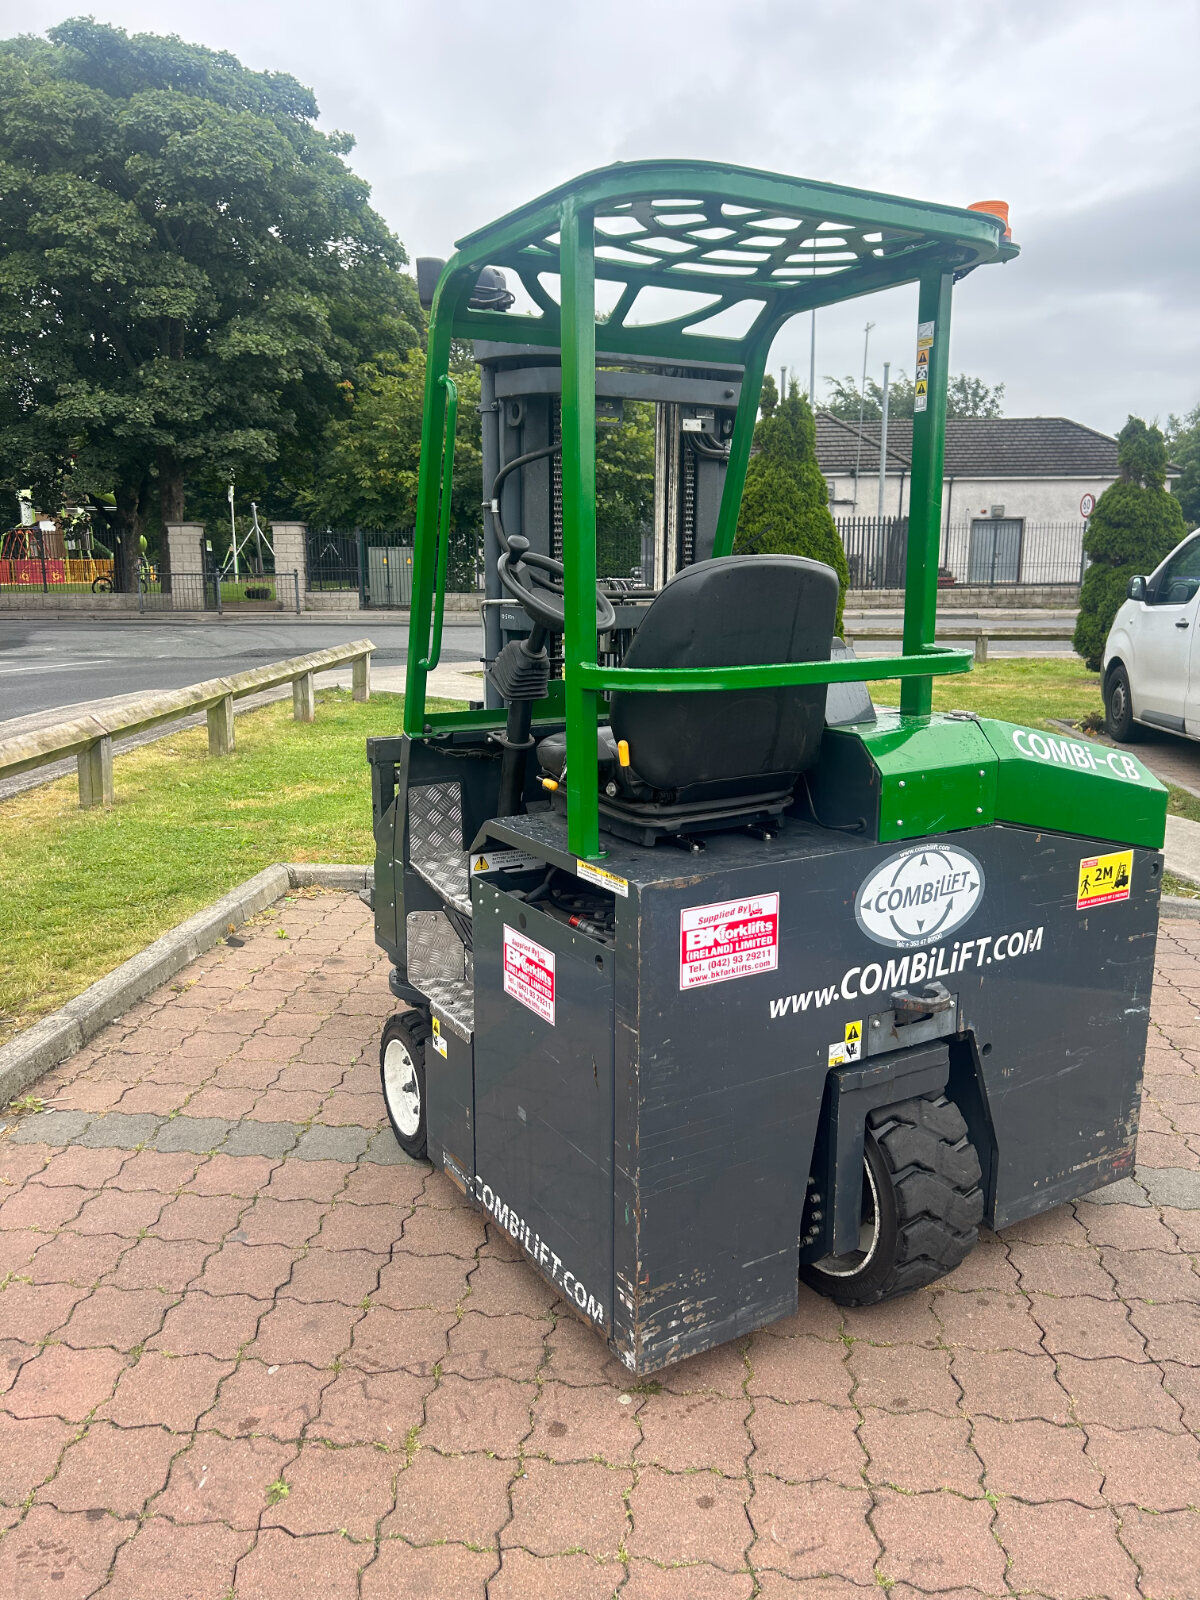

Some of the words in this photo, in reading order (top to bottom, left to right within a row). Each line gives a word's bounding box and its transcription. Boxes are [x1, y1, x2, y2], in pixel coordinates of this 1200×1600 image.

[899, 844, 951, 858] www.combilift.com
[1095, 866, 1113, 881] 2M
[698, 908, 735, 925] Supplied
[738, 906, 748, 915] By
[686, 943, 733, 962] (IRELAND)
[735, 936, 773, 951] LIMITED
[689, 963, 705, 973] Tel.
[708, 958, 730, 971] (042)
[733, 955, 743, 964] 93
[746, 949, 771, 961] 29211
[689, 961, 770, 983] www.bkforklifts.com
[530, 977, 552, 999] LIMITED
